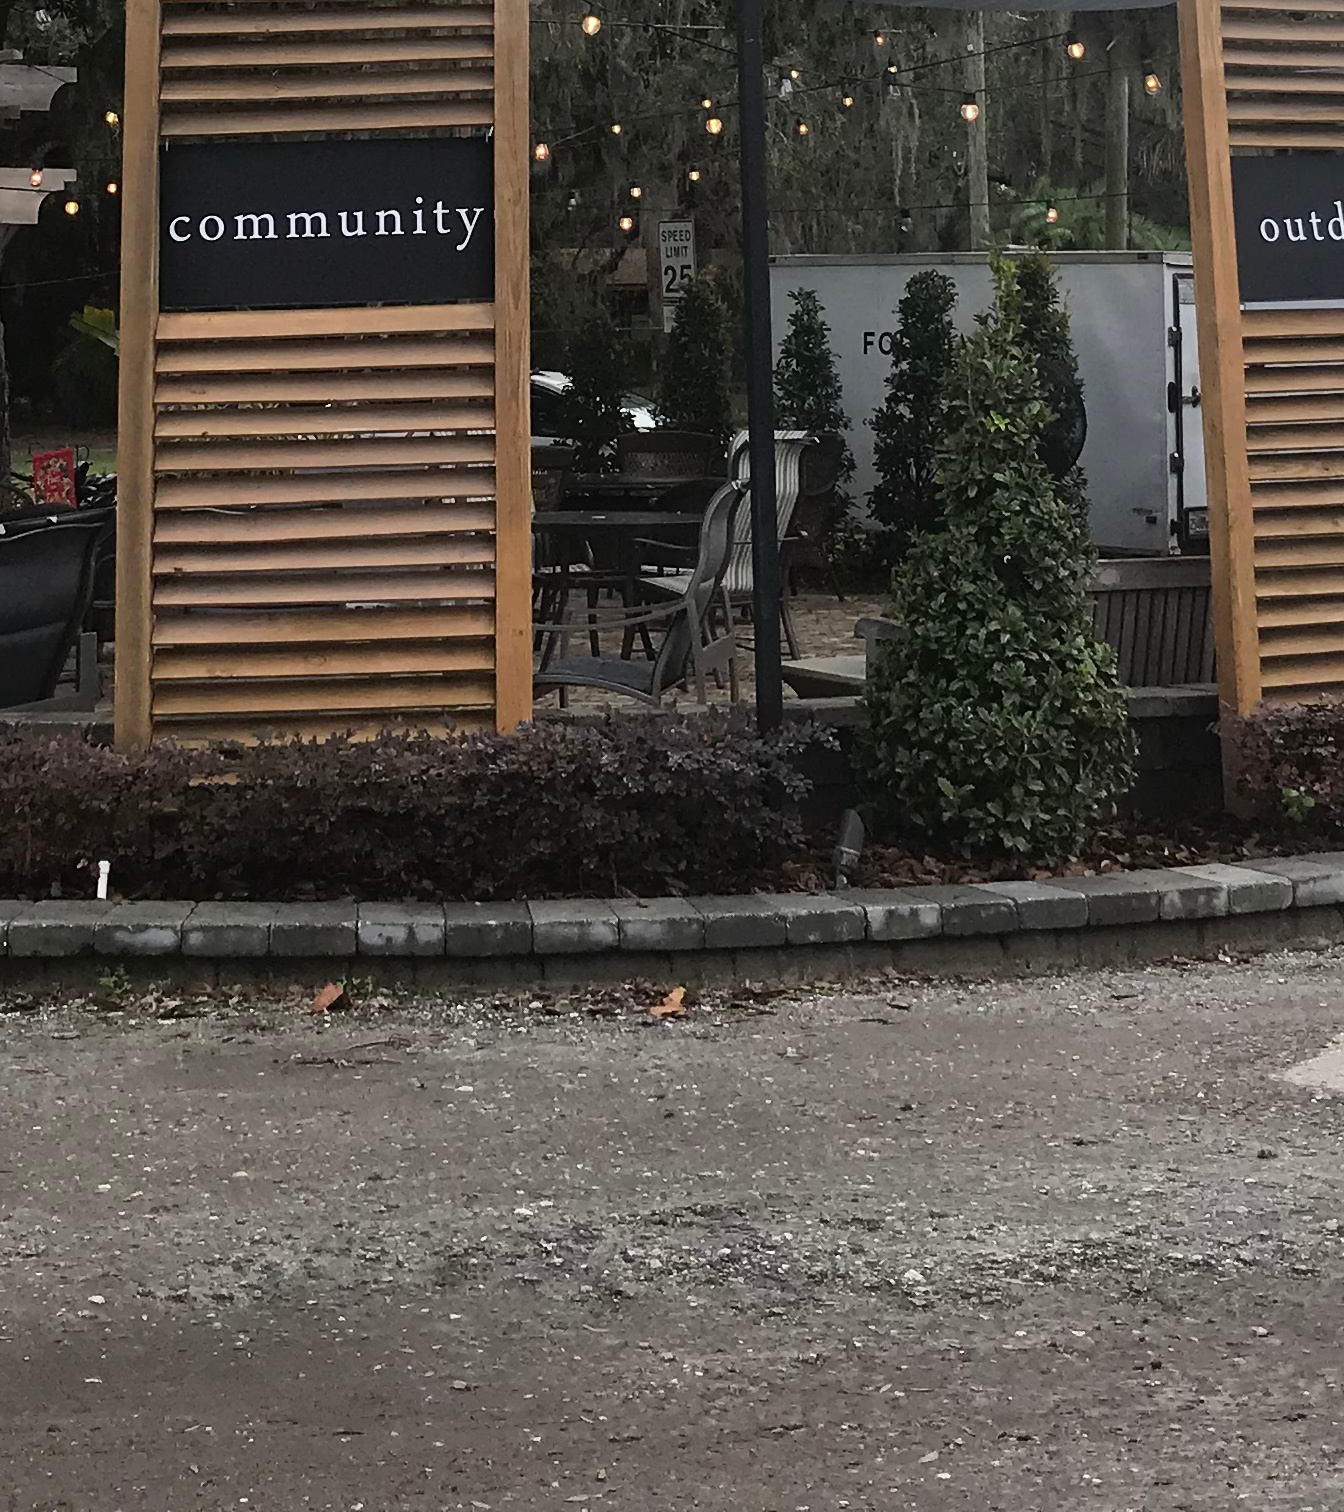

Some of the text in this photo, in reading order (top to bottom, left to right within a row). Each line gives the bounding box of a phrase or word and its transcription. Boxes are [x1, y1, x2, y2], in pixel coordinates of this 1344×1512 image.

[169, 197, 485, 251] community
[661, 229, 691, 242] SPEED
[665, 246, 688, 258] LIMIT
[664, 264, 693, 293] 25
